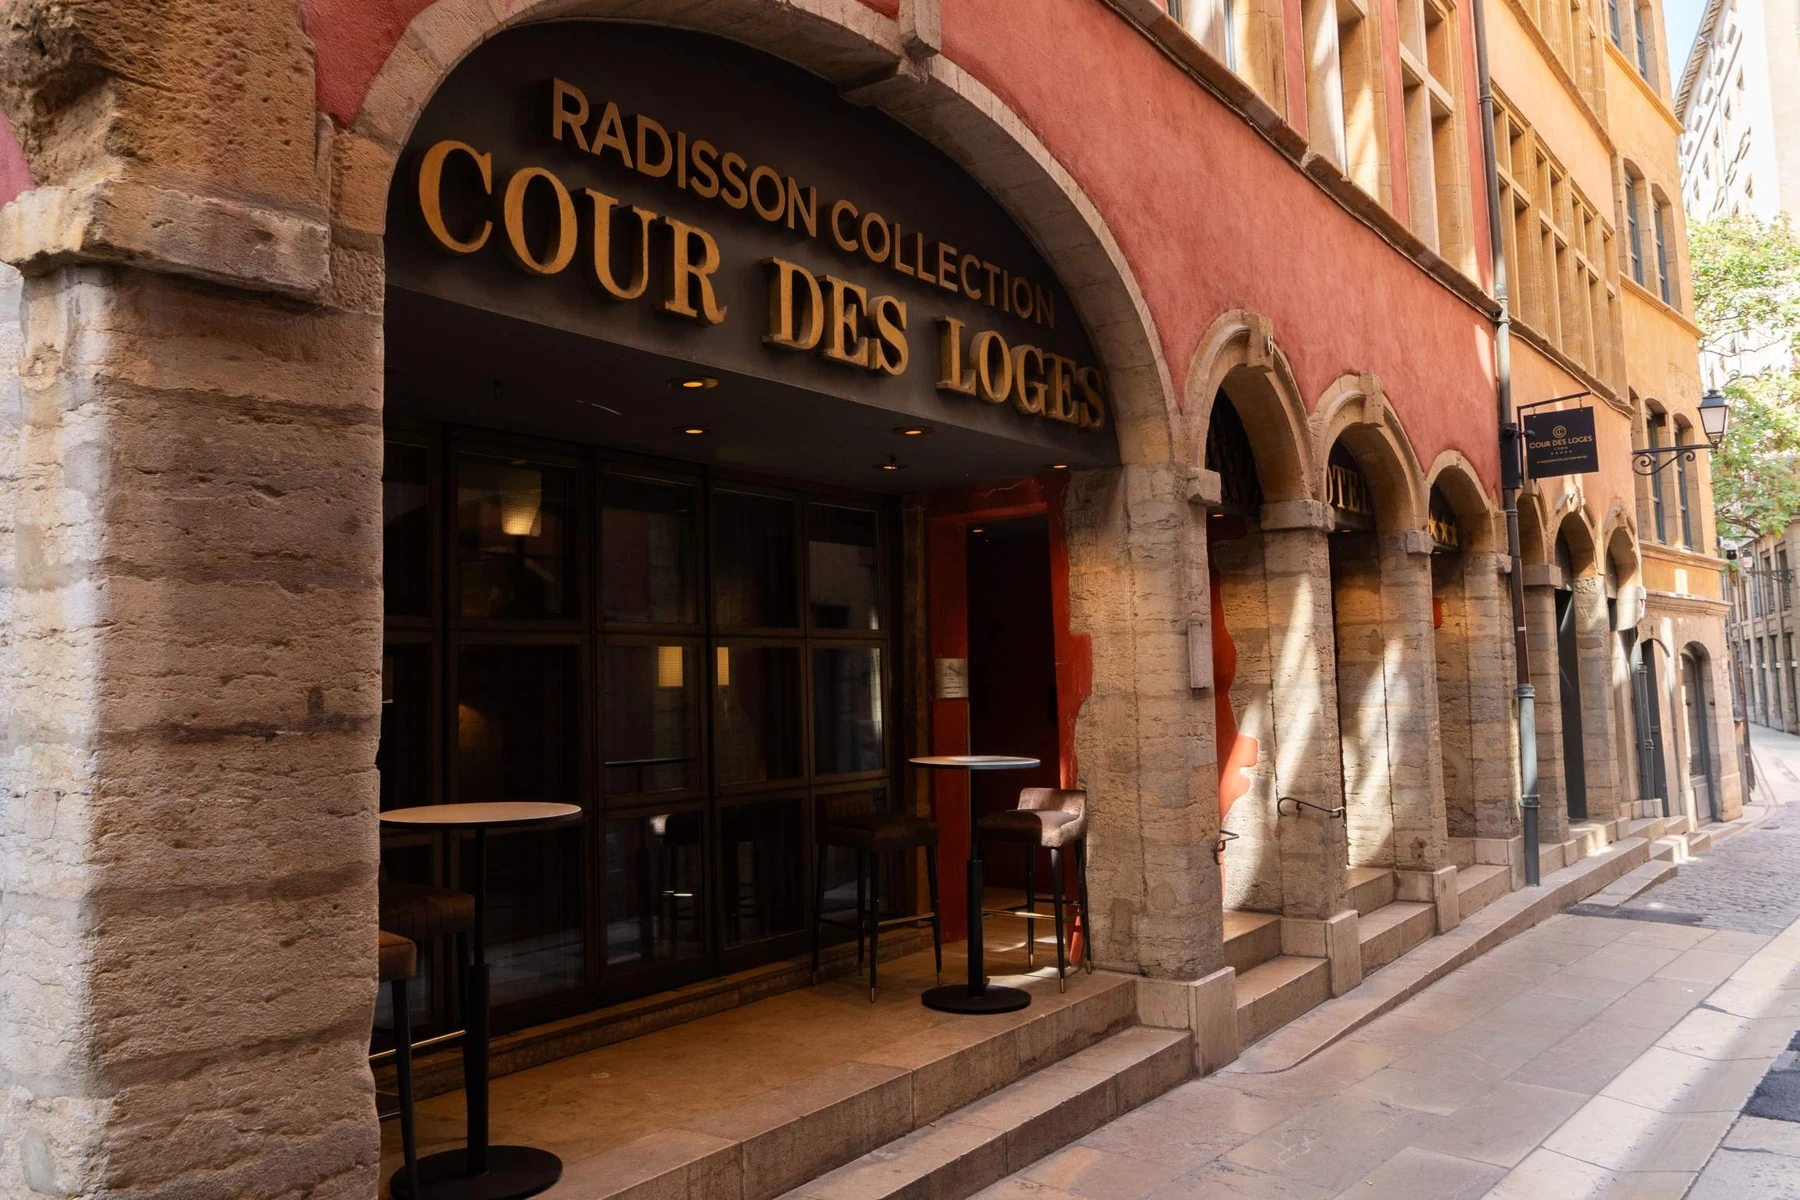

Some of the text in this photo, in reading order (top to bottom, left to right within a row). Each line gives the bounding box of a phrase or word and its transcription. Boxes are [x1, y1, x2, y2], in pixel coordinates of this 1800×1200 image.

[418, 139, 1106, 430] COUR DES LOGES
[552, 76, 1056, 329] RADISSON COLLECTION
[1529, 435, 1593, 449] COUR DES LOGES
